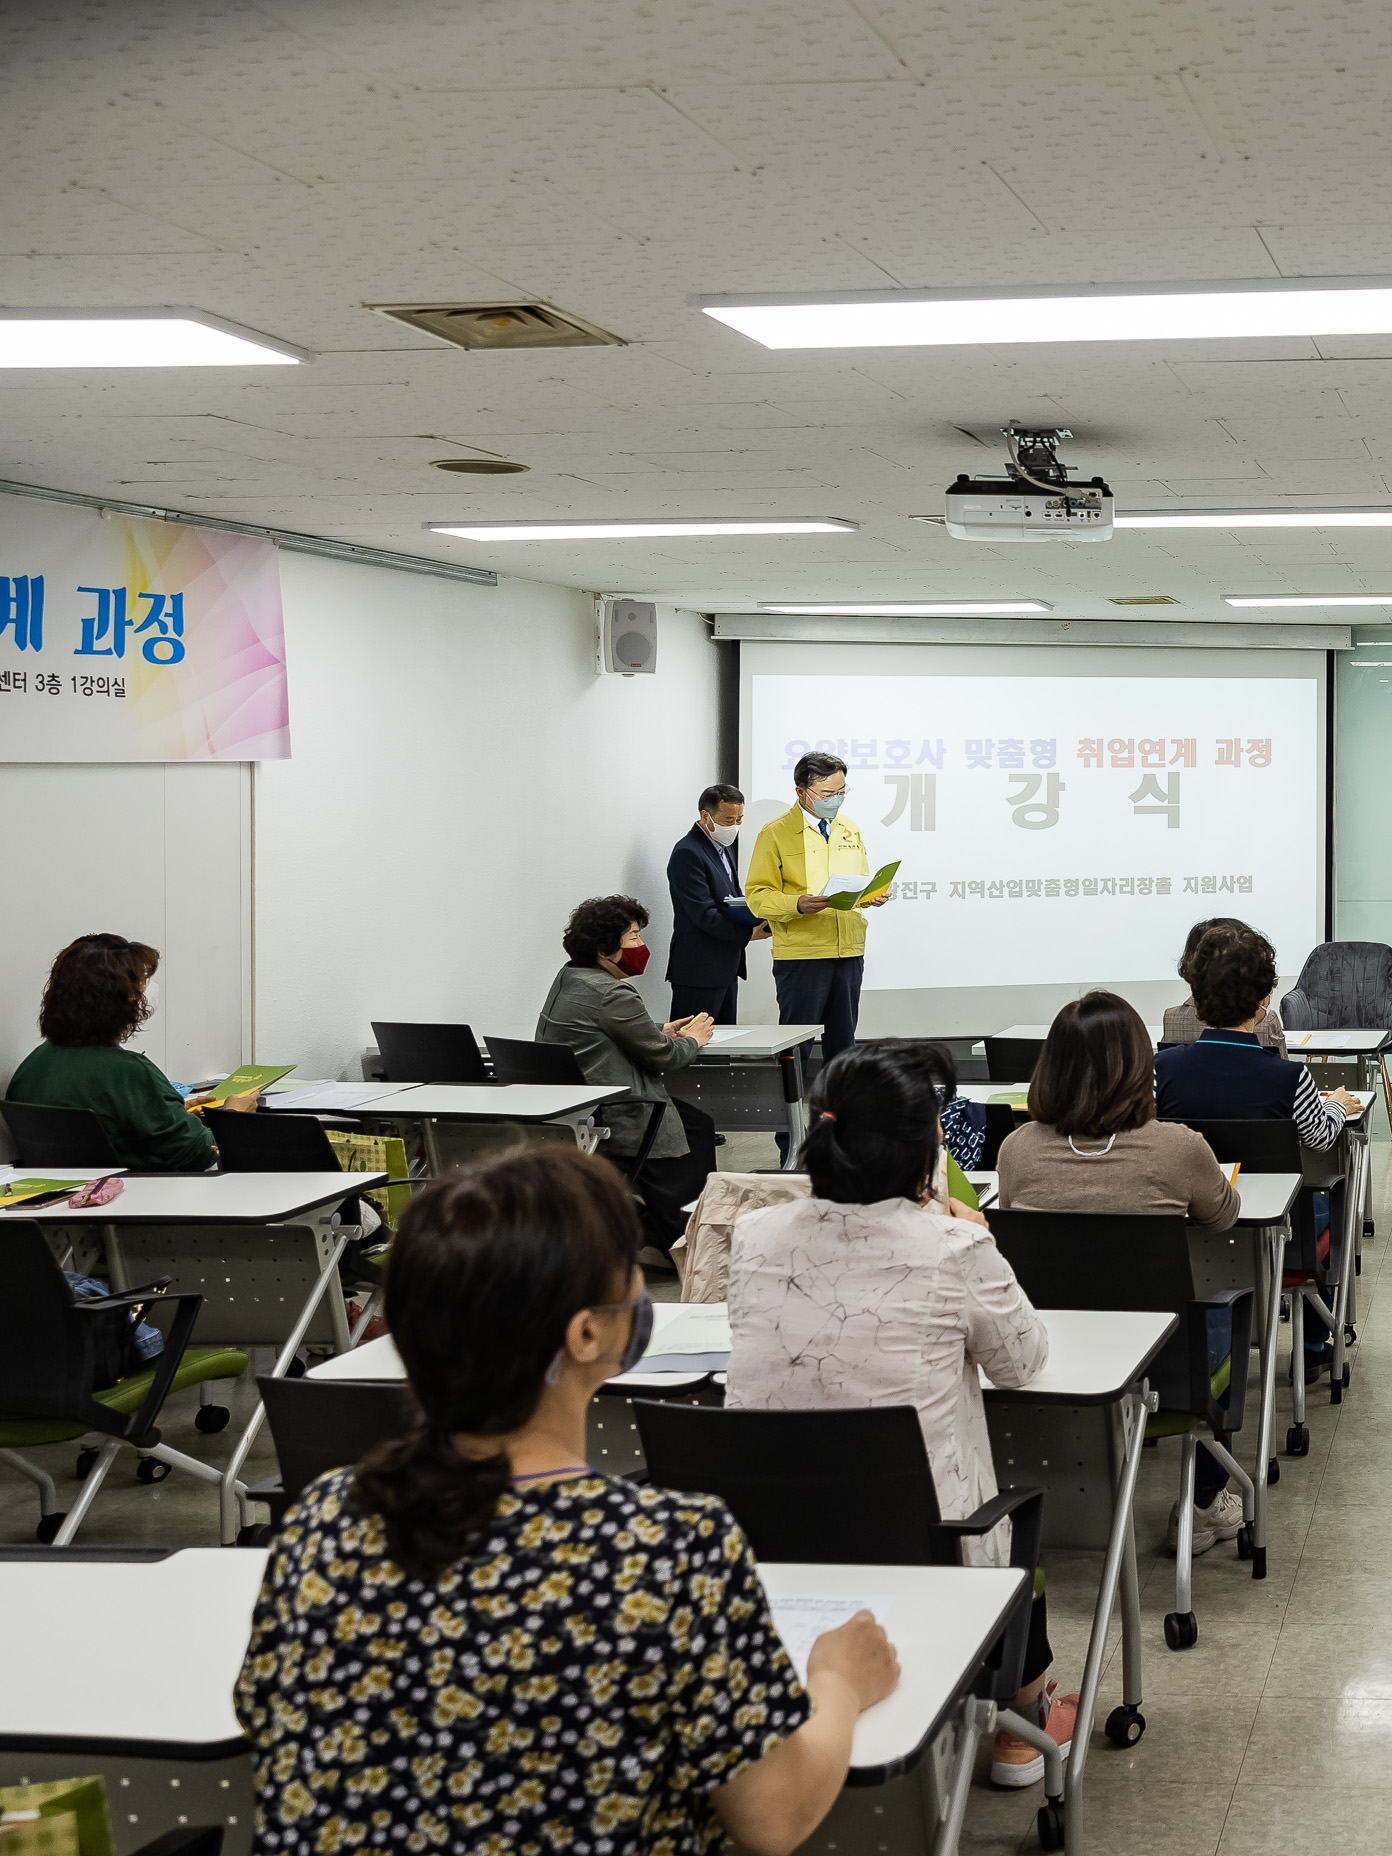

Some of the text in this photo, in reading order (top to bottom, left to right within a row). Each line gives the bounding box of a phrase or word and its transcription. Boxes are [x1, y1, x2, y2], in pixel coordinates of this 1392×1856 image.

[73, 585, 185, 665] 과정
[0, 670, 127, 698] 센터 3층 1강의실
[964, 738, 1057, 770] 맞춤형
[1076, 738, 1197, 769] 취업연계
[1214, 738, 1272, 768] 과정
[880, 771, 1181, 832] 개 강 식
[949, 877, 1172, 899] 지역산업맞춤형일자리창출
[1182, 875, 1253, 895] 지원사업
